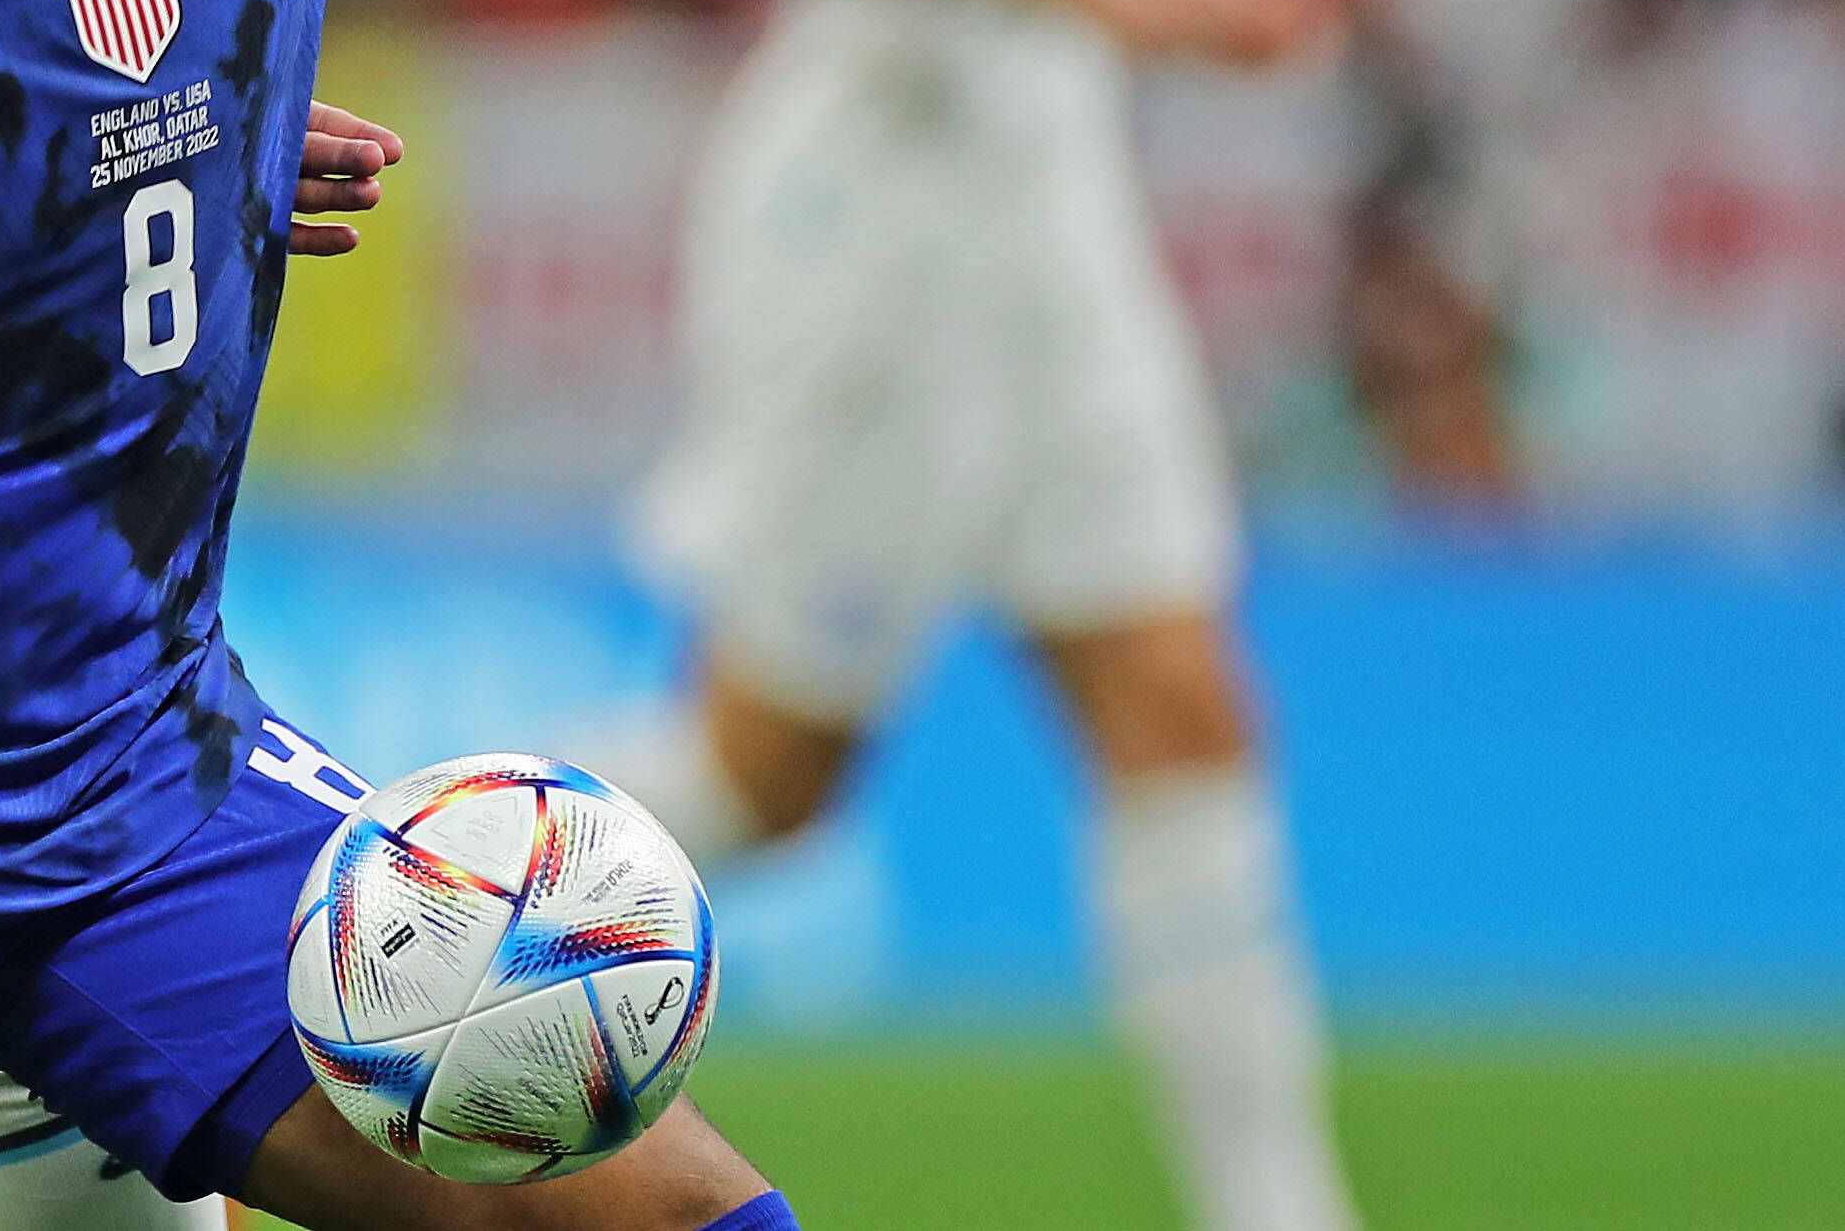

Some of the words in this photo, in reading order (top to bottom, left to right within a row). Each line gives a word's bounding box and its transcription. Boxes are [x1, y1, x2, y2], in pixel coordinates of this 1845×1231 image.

[90, 98, 160, 137] ENGLAND
[162, 90, 183, 115] VS.
[185, 78, 212, 108] USA
[101, 134, 123, 161] AL
[122, 121, 165, 154] KHOR,
[165, 105, 208, 140] QATAR
[90, 161, 111, 189] 25
[113, 139, 183, 183] NOVEMBER
[185, 124, 220, 157] 2022
[122, 178, 198, 377] 8
